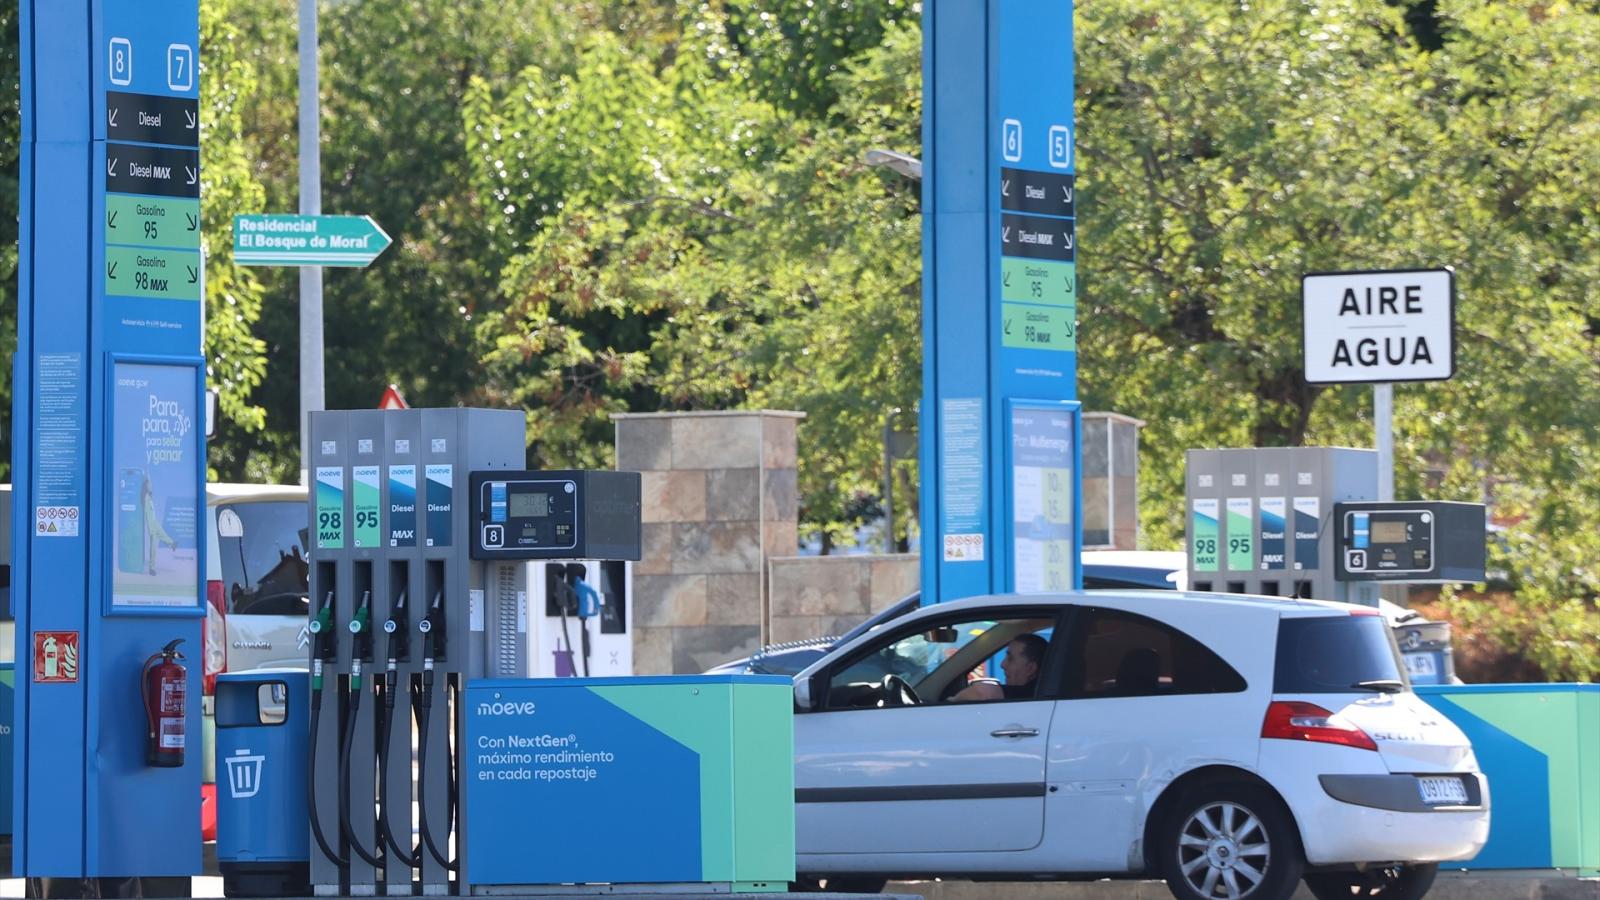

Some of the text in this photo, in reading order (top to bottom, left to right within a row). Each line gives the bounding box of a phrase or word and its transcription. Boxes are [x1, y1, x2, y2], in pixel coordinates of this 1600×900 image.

[116, 50, 124, 73] 8
[175, 56, 184, 79] 7
[139, 111, 161, 127] Diesel
[1008, 130, 1016, 151] 6
[1055, 136, 1063, 157] 5
[129, 162, 171, 180] Diesel MAX
[1025, 185, 1046, 199] Diesel
[136, 204, 165, 217] Gasolina
[144, 221, 158, 240] 95
[239, 219, 317, 232] Residencial
[239, 234, 368, 250] El Bosque de Moral
[1018, 230, 1037, 244] Diesel
[136, 255, 166, 268] Gasolina
[135, 272, 168, 292] 98 MAX
[1031, 281, 1042, 298] 95
[1338, 285, 1423, 316] AIRE
[1025, 326, 1036, 342] 98
[1331, 336, 1433, 367] AGUA
[142, 418, 172, 437] para,
[146, 438, 161, 448] para
[146, 450, 183, 465] y ganar
[355, 469, 377, 477] moeve
[427, 468, 450, 476] moeve
[391, 504, 415, 513] Diesel
[427, 503, 451, 512] Diesel
[319, 512, 342, 529] 98
[356, 512, 378, 528] 95
[319, 531, 341, 540] MAX
[392, 530, 414, 539] MAX
[490, 530, 497, 542] 8
[1262, 532, 1284, 540] Diesel
[1295, 531, 1317, 540] Diesel
[1196, 540, 1216, 554] 98
[1230, 539, 1250, 554] 95
[1196, 556, 1215, 564] MAX
[1263, 554, 1284, 562] MAX
[1352, 554, 1361, 566] 6
[477, 702, 535, 716] moeve
[478, 736, 505, 748] Con
[478, 750, 614, 764] máximo rendimiento
[478, 766, 597, 782] en cada repostaje
